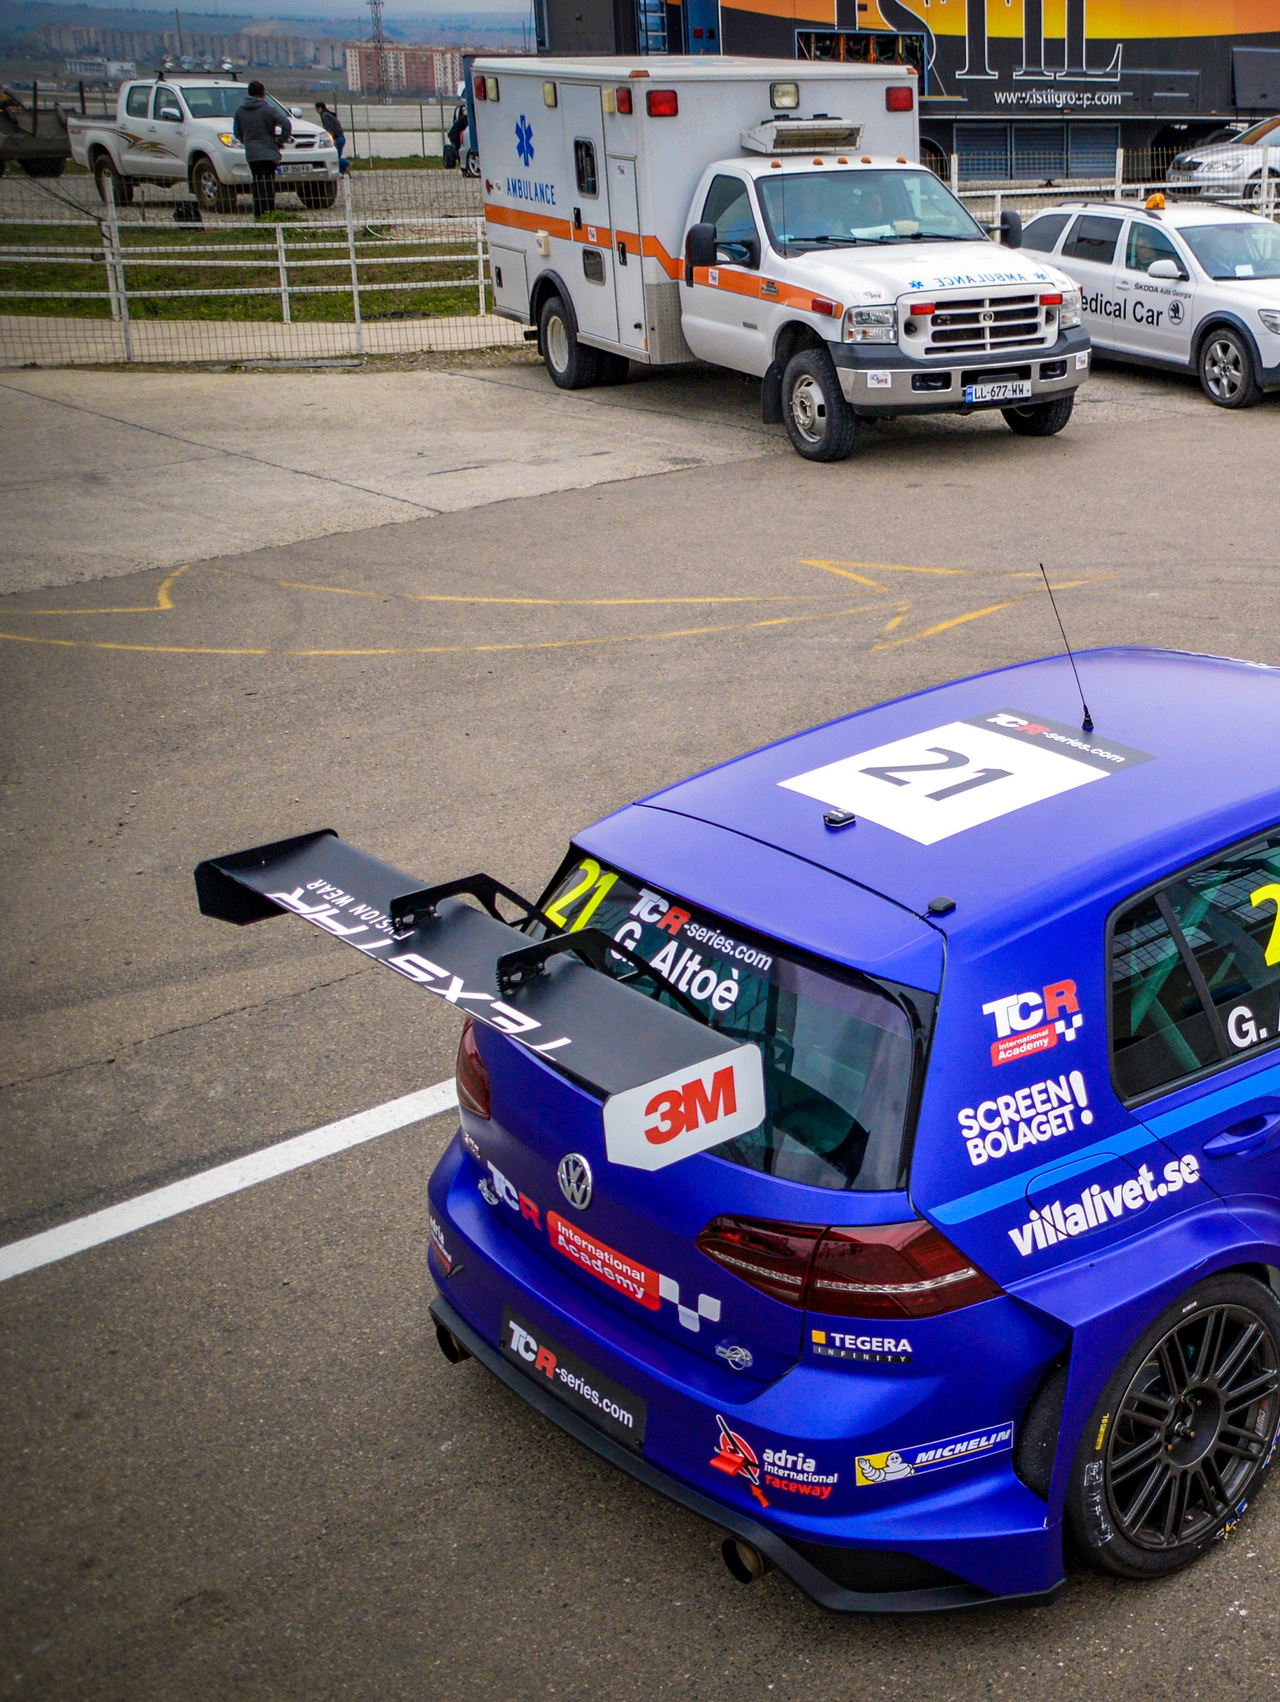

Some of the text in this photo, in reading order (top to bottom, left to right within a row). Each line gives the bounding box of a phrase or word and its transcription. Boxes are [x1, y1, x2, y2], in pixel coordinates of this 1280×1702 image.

[506, 177, 557, 205] AMBULANCE
[1081, 293, 1163, 326] edical Car
[974, 382, 1024, 399] LL-677-WW
[985, 712, 1126, 765] TCR-series.com
[858, 746, 1015, 802] 21
[306, 877, 353, 908] WEAR
[545, 857, 620, 933] 21
[629, 887, 774, 973] TCR-series.com
[648, 939, 740, 1012] Altoè
[982, 978, 1080, 1038] TCR
[1227, 1007, 1268, 1049] G.
[997, 1028, 1050, 1052] International
[997, 1036, 1051, 1063] Academy
[643, 1065, 737, 1146] 3M
[487, 1160, 542, 1231] TCR
[1008, 1154, 1200, 1257] villalivet.se
[557, 1221, 646, 1283] International
[557, 1234, 646, 1300] Academy
[816, 1347, 909, 1364] INFINITY
[830, 1332, 913, 1353] TEGERA
[507, 1320, 634, 1429] TCR-series.com
[763, 1447, 816, 1473] adria
[915, 1428, 1011, 1464] MICHELIN
[764, 1462, 838, 1484] international
[764, 1474, 832, 1500] raceway
